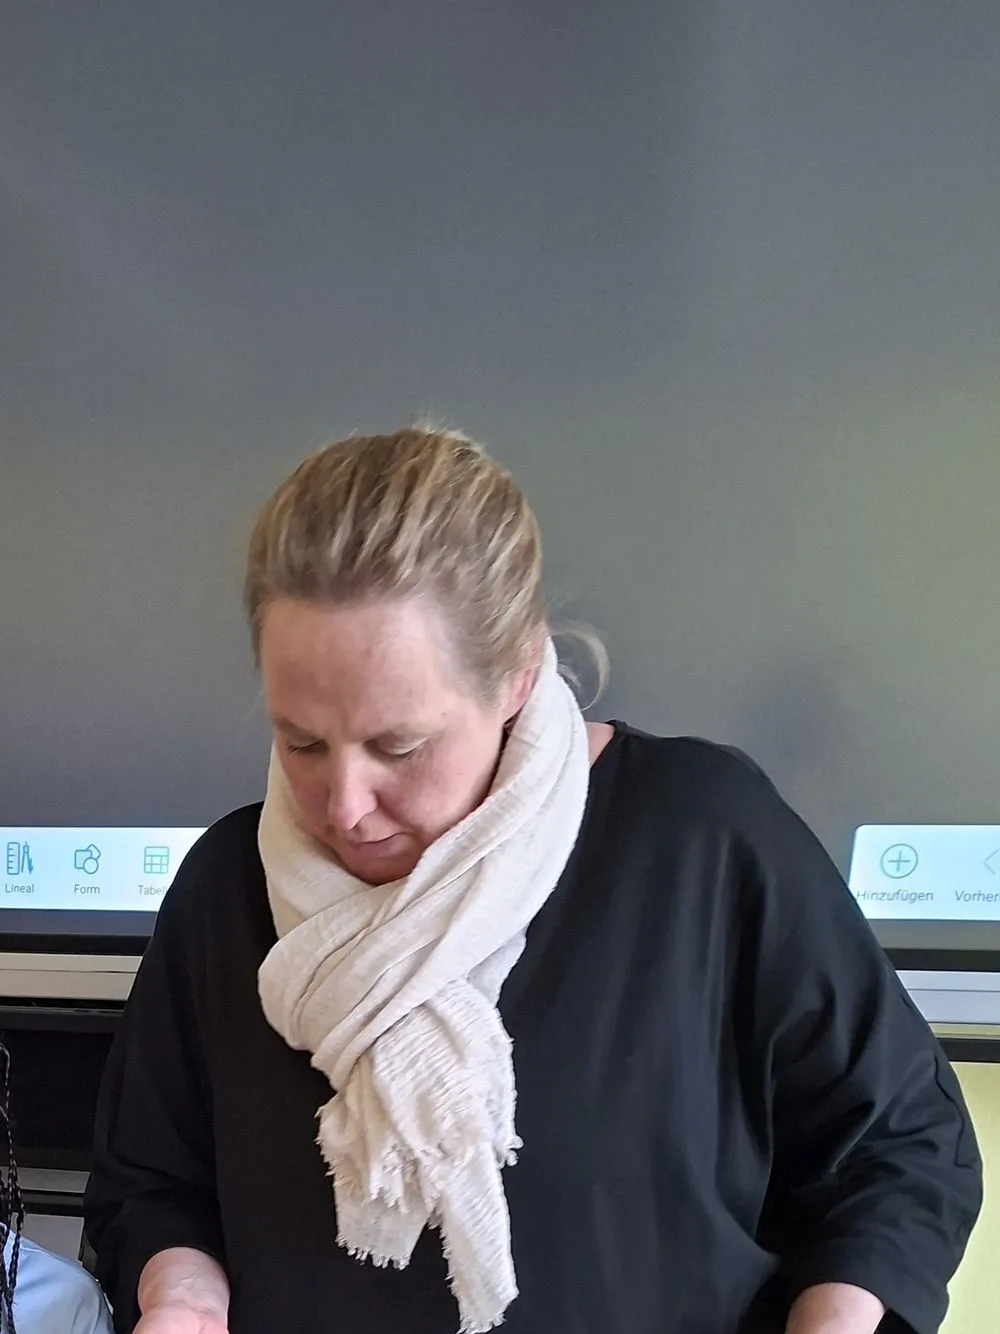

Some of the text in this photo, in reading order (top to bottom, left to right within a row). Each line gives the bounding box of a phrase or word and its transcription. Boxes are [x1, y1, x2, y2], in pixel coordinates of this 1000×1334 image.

[5, 883, 35, 894] Lineal
[74, 884, 101, 895] Form
[856, 889, 934, 903] Hinzufügen
